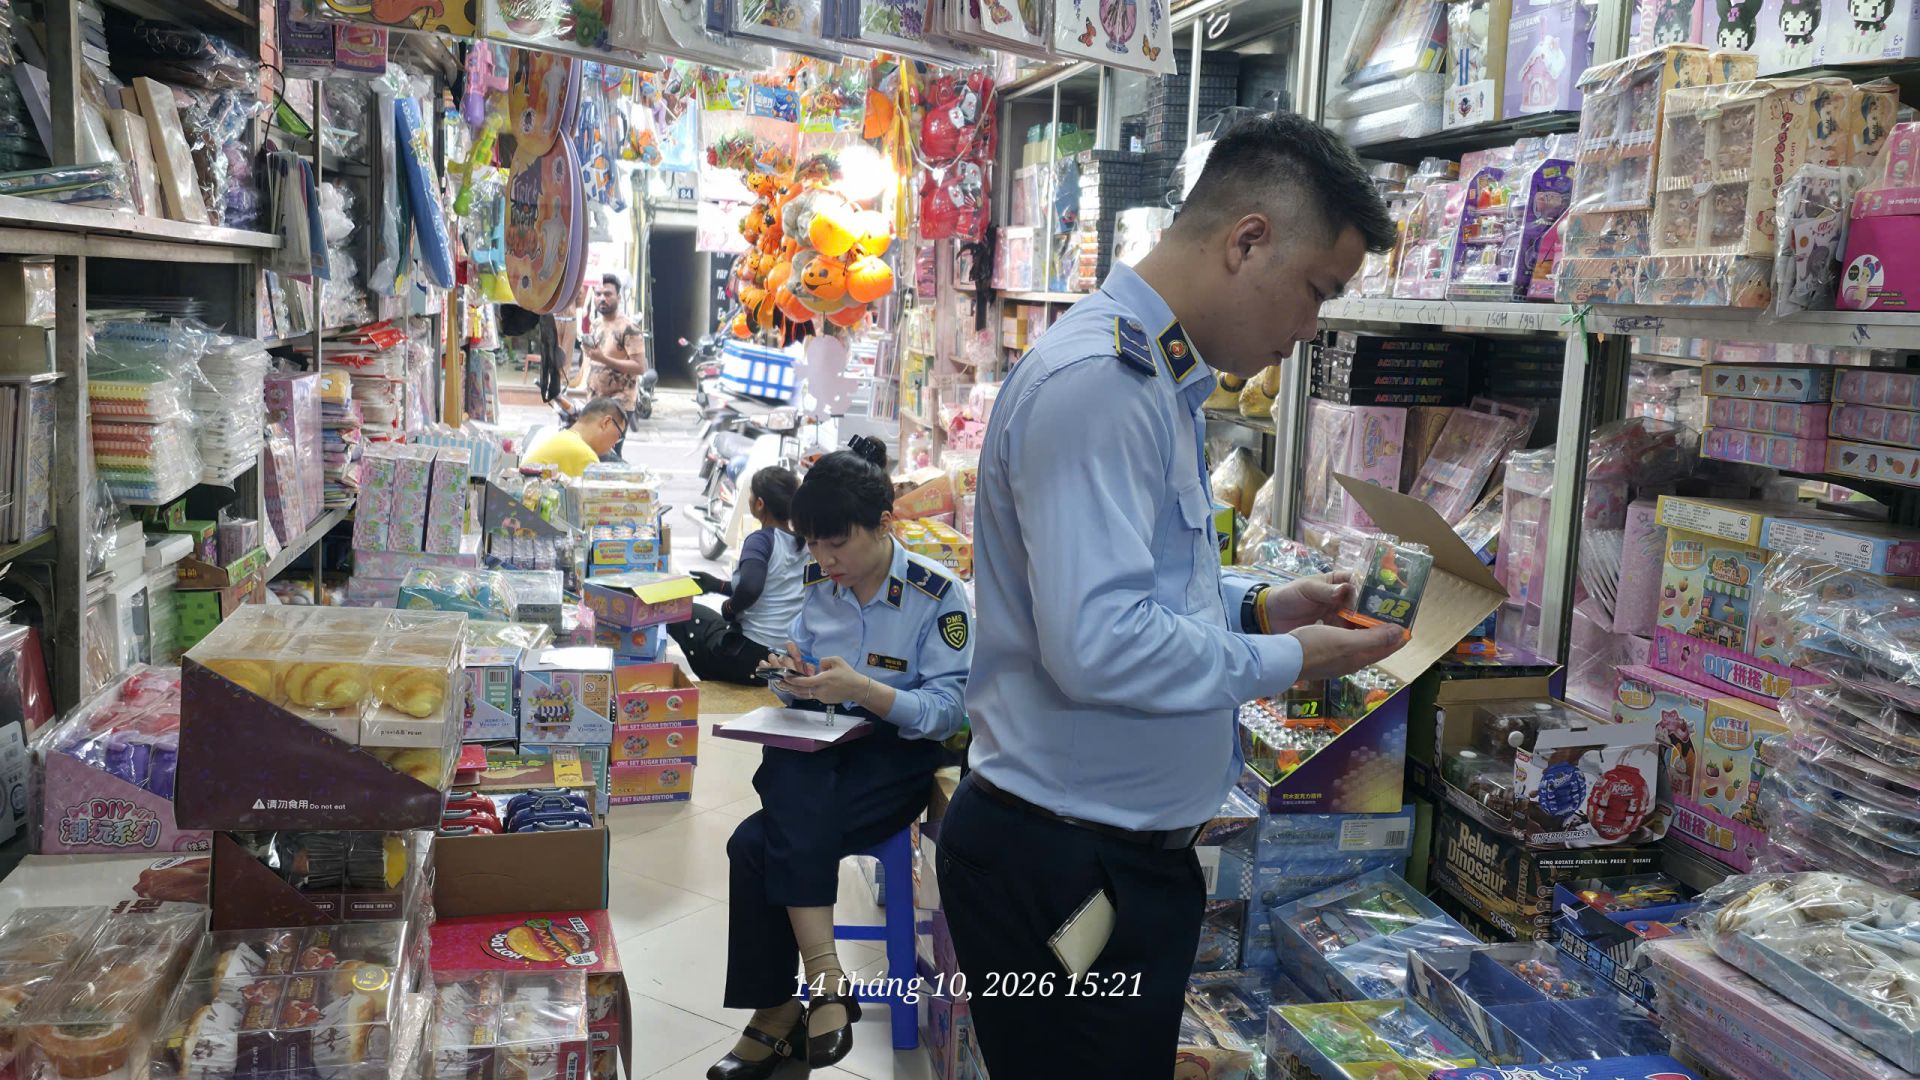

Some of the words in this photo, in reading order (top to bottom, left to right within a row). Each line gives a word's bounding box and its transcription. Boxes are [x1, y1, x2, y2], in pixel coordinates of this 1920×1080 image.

[680, 189, 692, 199] 84
[1378, 598, 1411, 618] 03
[946, 615, 962, 625] DMS
[91, 802, 133, 819] DIY
[267, 799, 309, 810] 请勿食用
[61, 819, 160, 845] 潮玩系列
[1565, 829, 1589, 840] STRESS
[1457, 821, 1499, 867] Relief
[1447, 838, 1508, 896] Dinosaur
[1490, 911, 1517, 938] 24PCS
